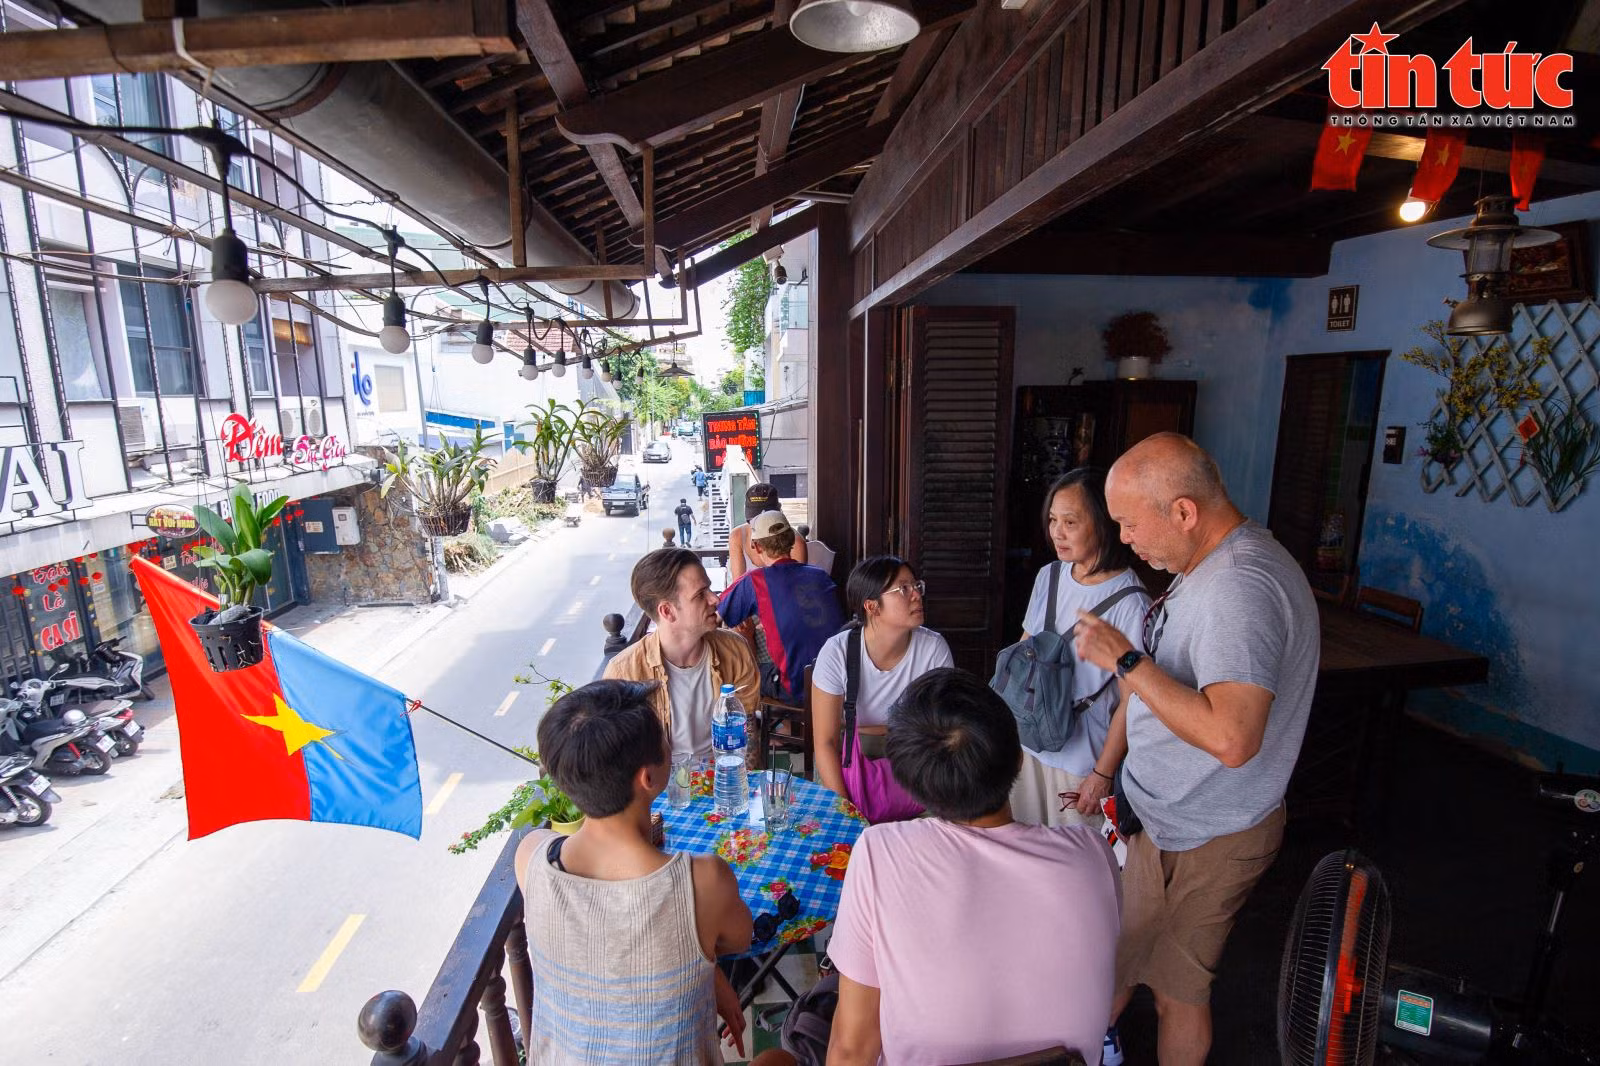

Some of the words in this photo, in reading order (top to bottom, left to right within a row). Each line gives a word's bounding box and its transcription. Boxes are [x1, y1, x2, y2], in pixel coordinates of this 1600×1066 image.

[1329, 319, 1350, 328] TOILET
[707, 420, 736, 433] TRUNG
[43, 590, 66, 612] Là
[41, 623, 65, 651] CA
